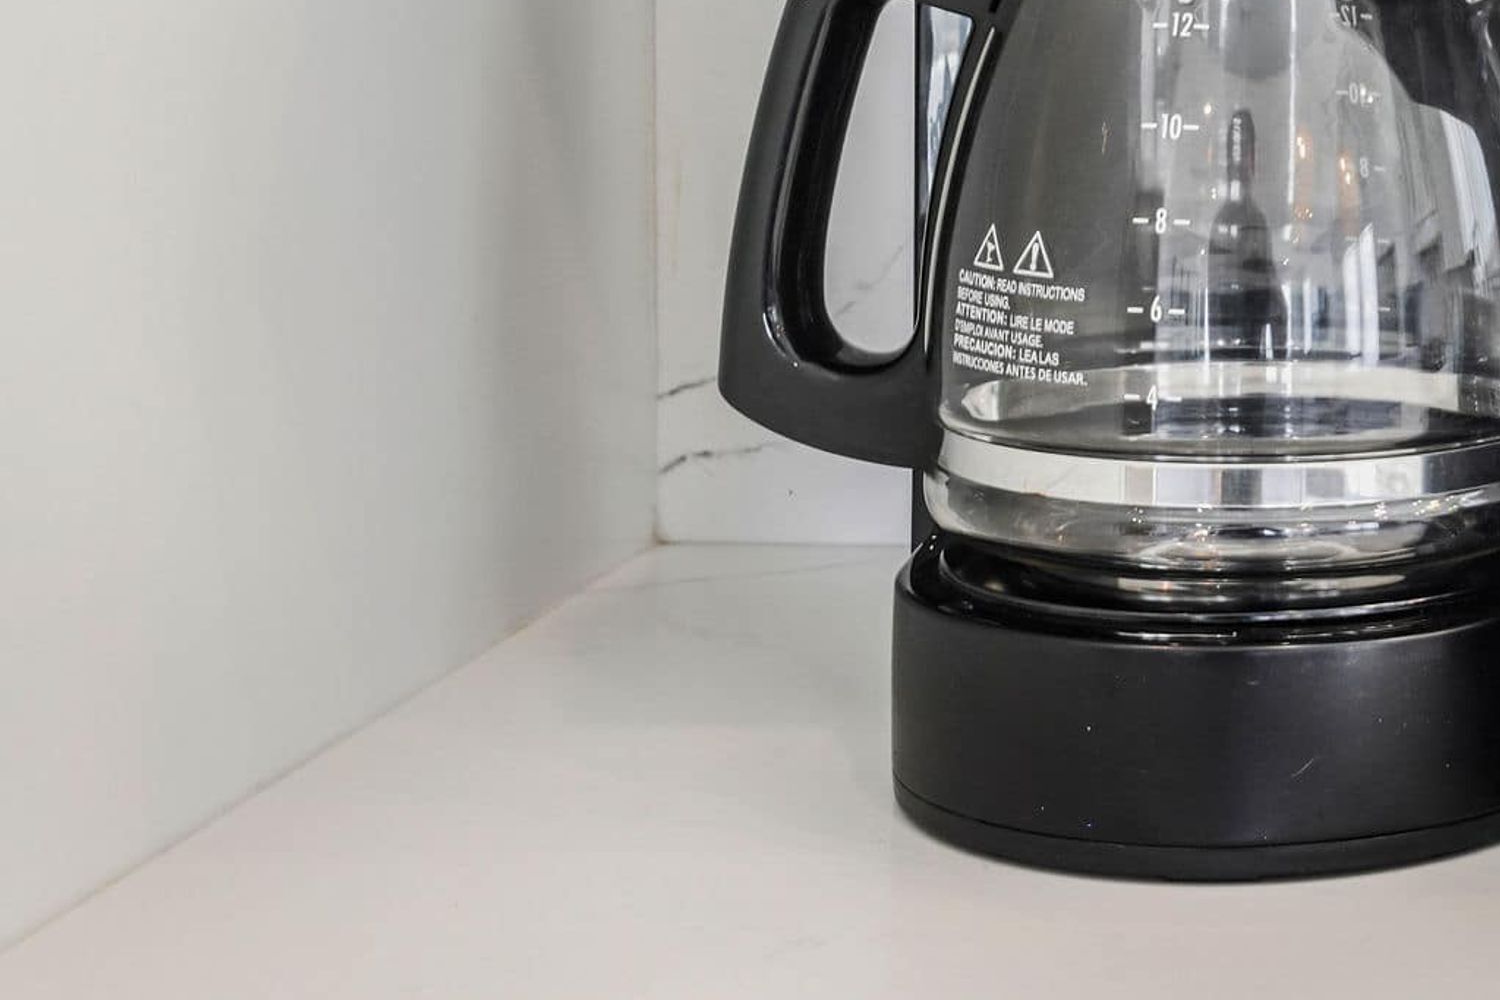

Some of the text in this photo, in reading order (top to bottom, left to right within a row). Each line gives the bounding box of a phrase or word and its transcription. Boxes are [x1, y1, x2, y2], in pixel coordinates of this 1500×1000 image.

[957, 285, 983, 305] BEFORE
[996, 278, 1017, 294] READ
[1018, 281, 1085, 302] INSTRUCTIONS
[955, 301, 1075, 336] ATTENTION: LIRE LE MODE
[984, 325, 1010, 341] AVANT
[1010, 331, 1044, 348] USAGE.
[1019, 347, 1037, 363] LEA
[1038, 349, 1060, 366] LAS
[1005, 362, 1036, 381] ANTES
[1038, 367, 1052, 381] DE
[1053, 370, 1088, 386] USAR.
